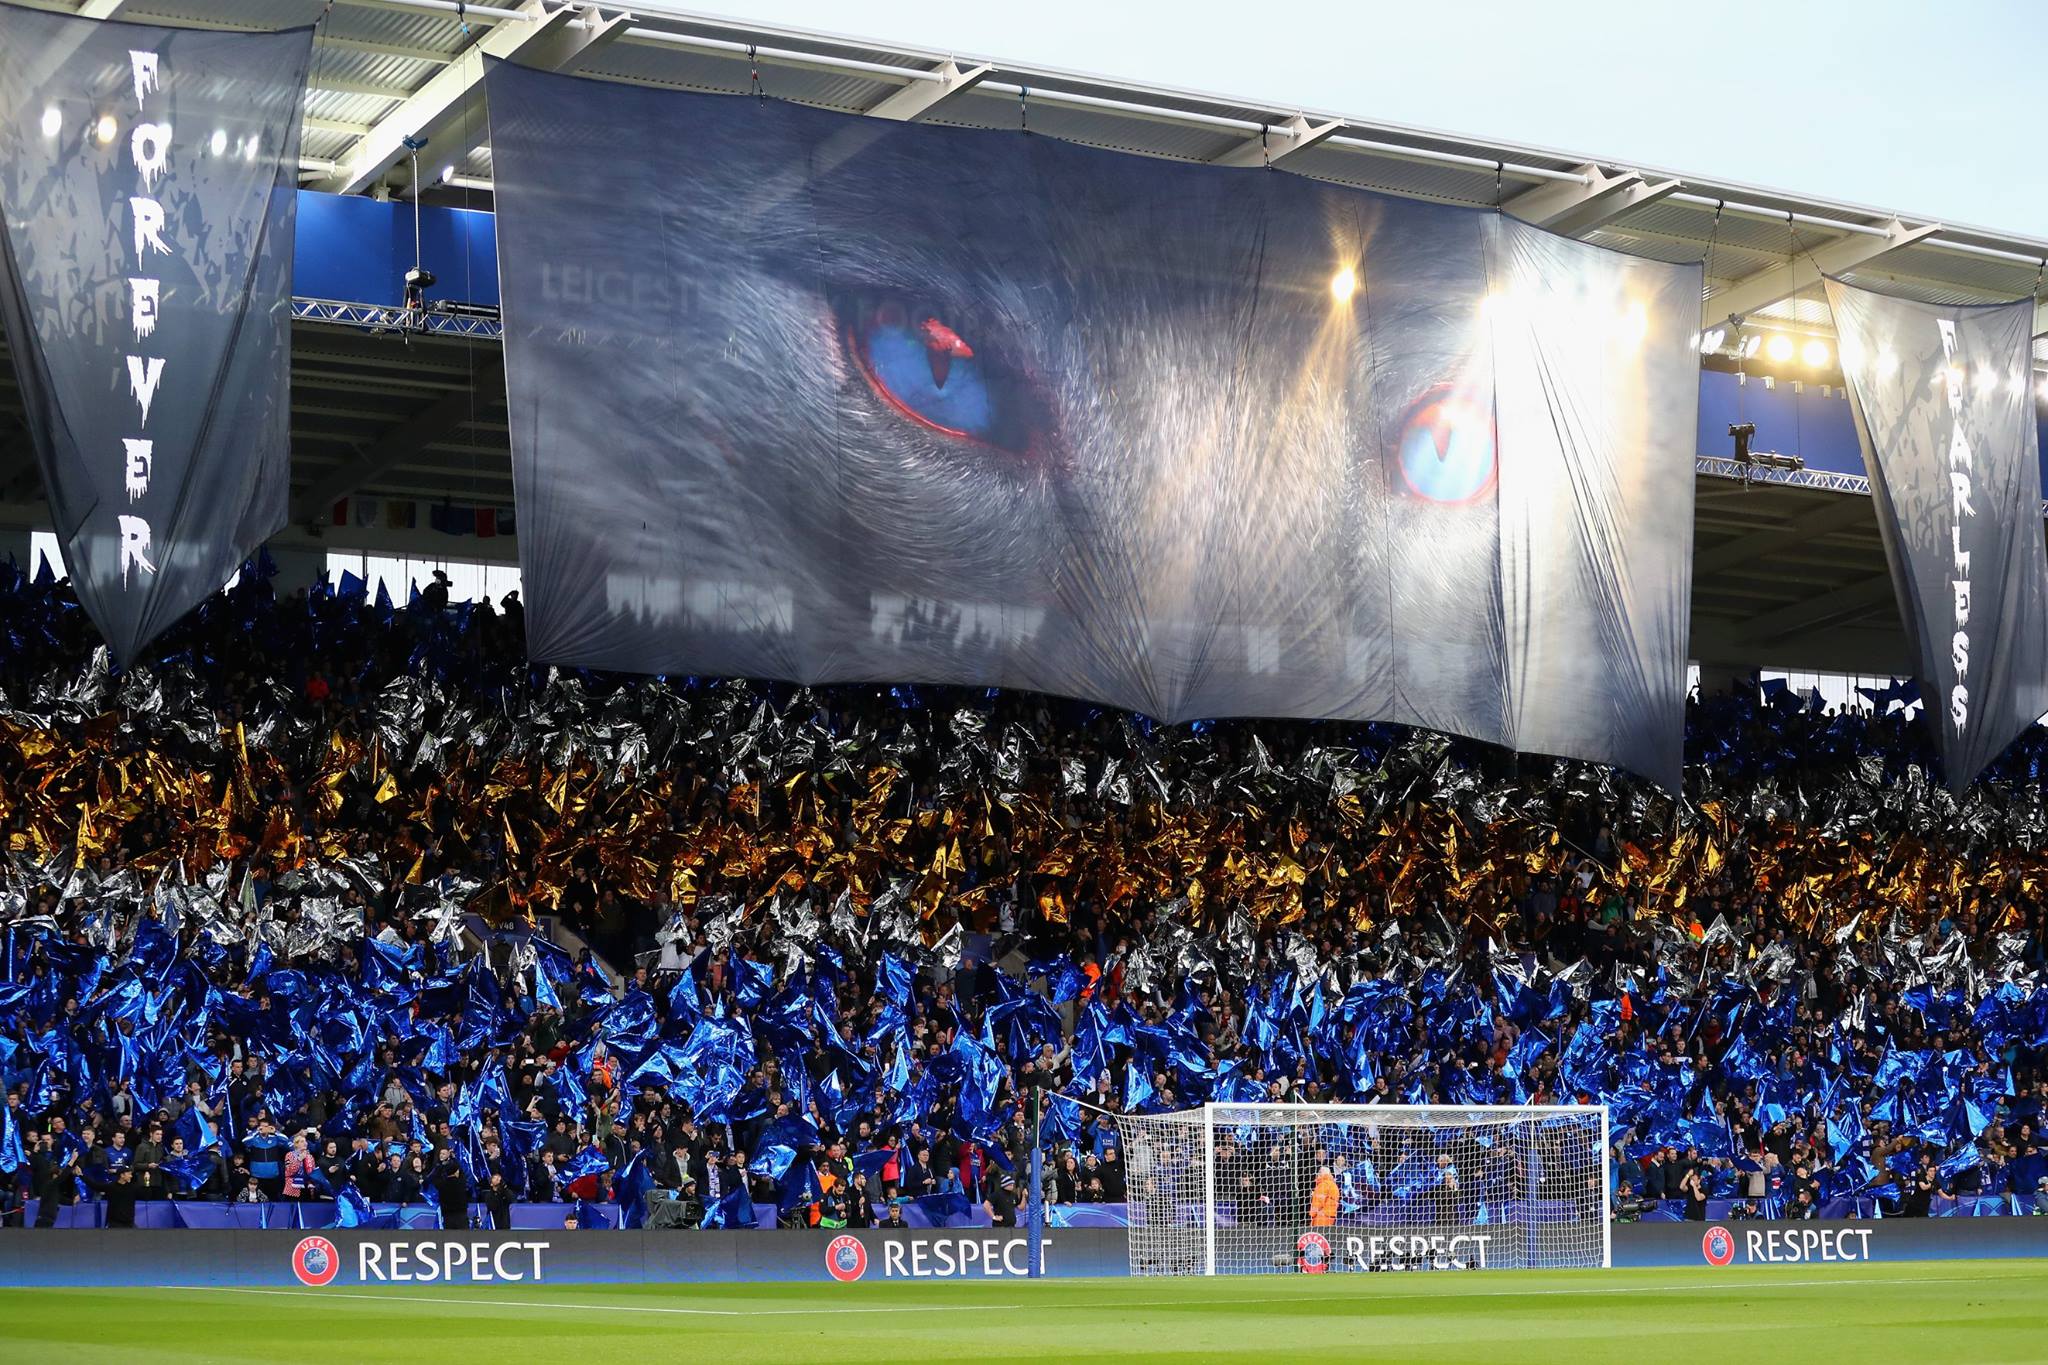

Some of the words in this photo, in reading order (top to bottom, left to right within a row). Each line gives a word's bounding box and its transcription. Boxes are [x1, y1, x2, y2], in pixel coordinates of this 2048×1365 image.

[118, 50, 172, 592] FOREVER
[1936, 319, 1976, 740] FEARLESS
[302, 1239, 329, 1251] UEFA
[833, 1238, 858, 1249] UEFA
[1301, 1235, 1324, 1246] UEFA
[1708, 1230, 1727, 1239] UEFA
[1747, 1228, 1872, 1262] RESPECT
[359, 1242, 549, 1281] RESPECT
[884, 1239, 1052, 1277] RESPECT
[1346, 1235, 1491, 1271] RESPECT
